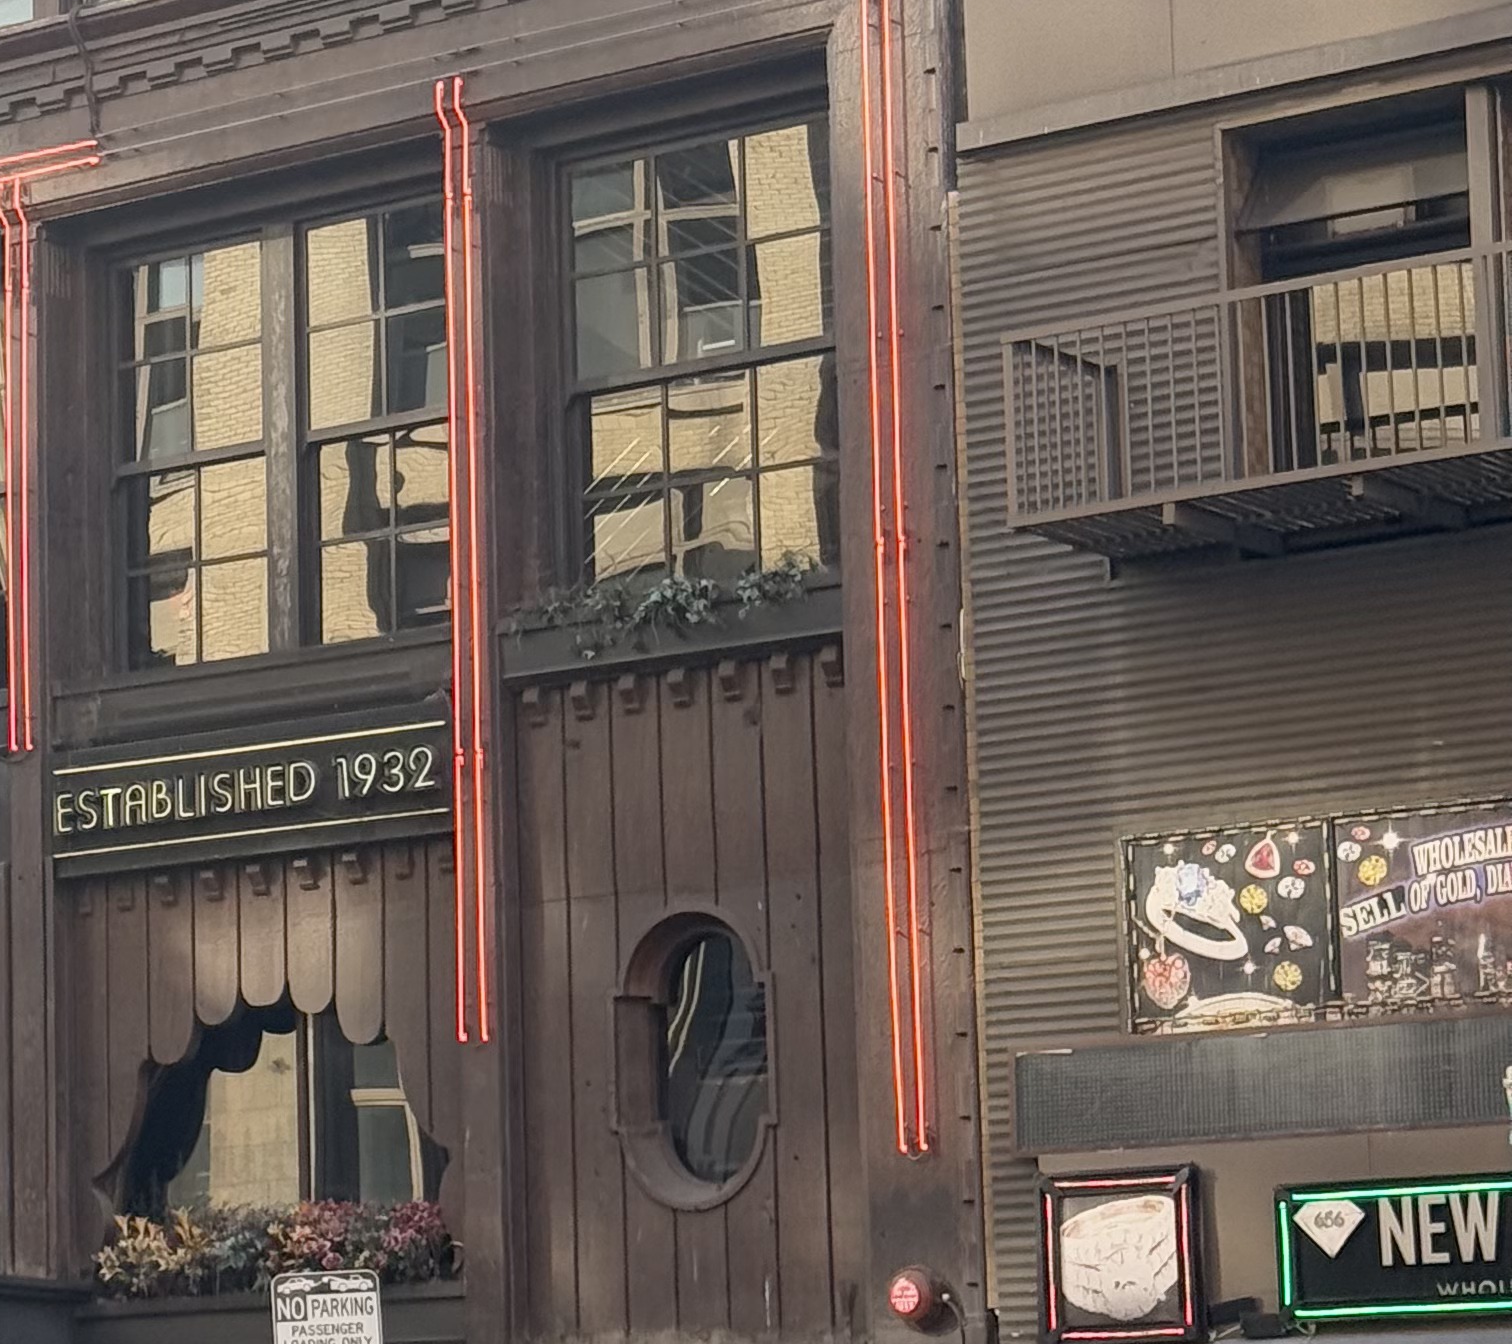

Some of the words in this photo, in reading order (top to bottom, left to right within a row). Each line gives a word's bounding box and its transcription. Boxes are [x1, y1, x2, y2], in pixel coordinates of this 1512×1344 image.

[54, 762, 316, 834] ESTABLISHED
[336, 746, 438, 800] 1932
[1409, 880, 1431, 913] OF
[1436, 869, 1482, 904] GOLD,
[1339, 891, 1407, 938] SELL
[1313, 1210, 1345, 1230] 656
[1378, 1190, 1500, 1268] NEW
[276, 1297, 306, 1321] NO
[311, 1296, 374, 1318] PARKING
[291, 1322, 364, 1337] PASSENGER
